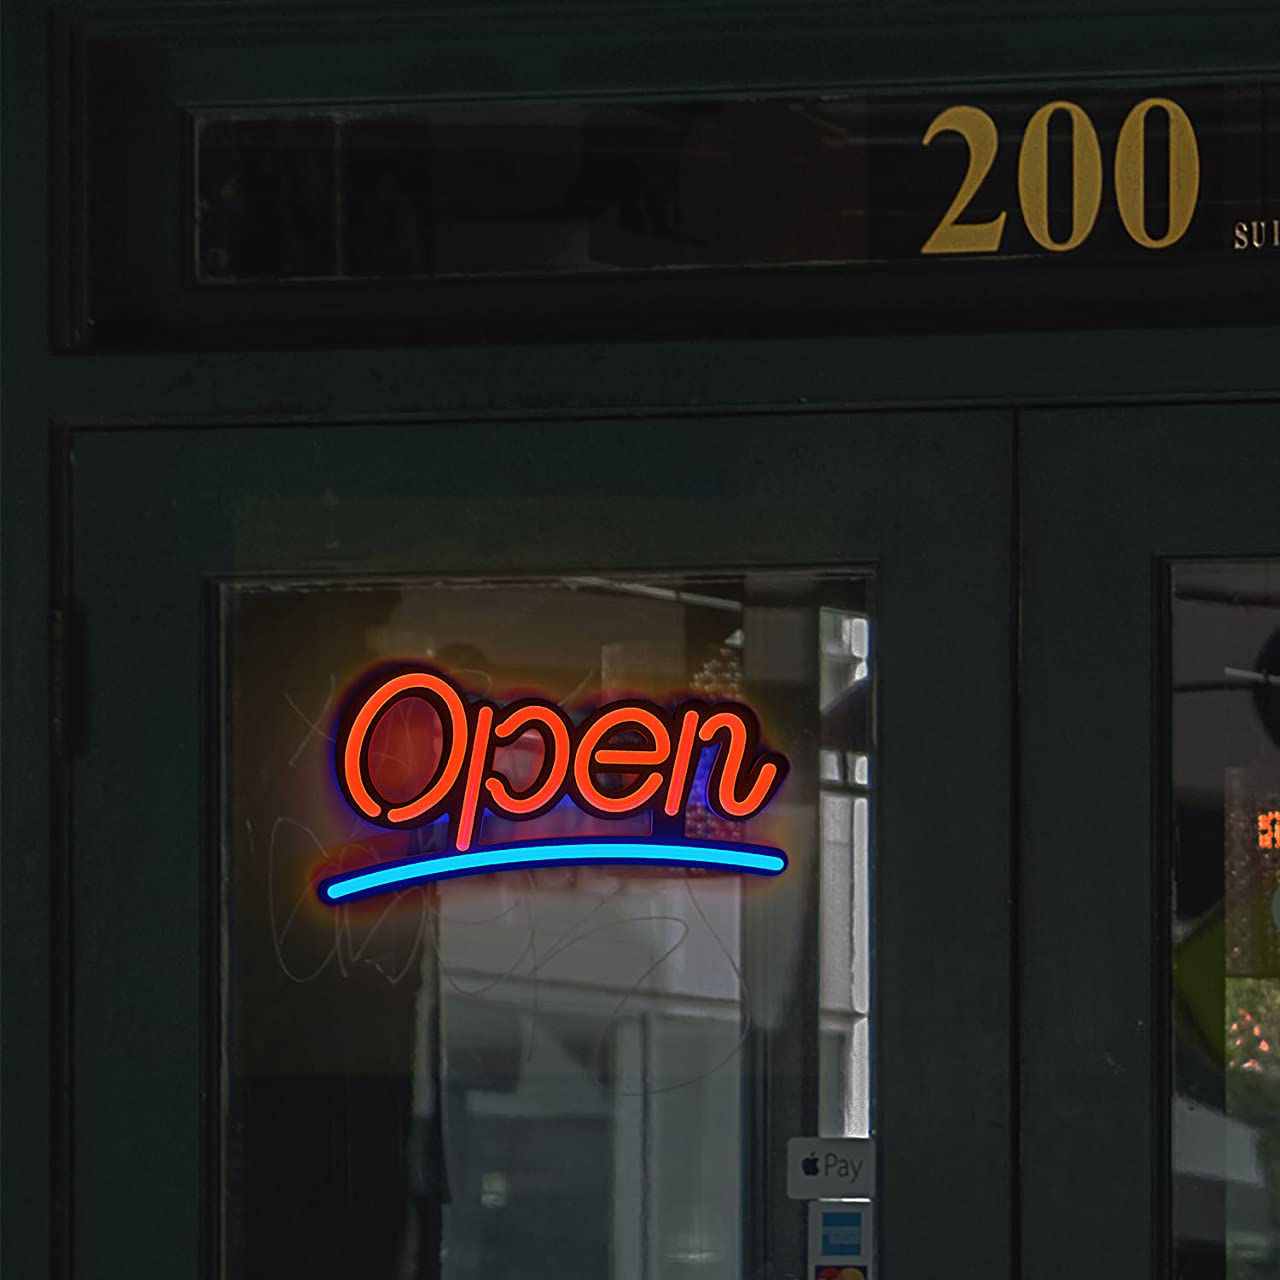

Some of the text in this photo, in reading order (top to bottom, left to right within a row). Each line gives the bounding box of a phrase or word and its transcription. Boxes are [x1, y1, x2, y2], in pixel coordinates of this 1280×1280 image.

[920, 97, 1200, 254] 200
[344, 672, 778, 851] Open
[824, 1152, 864, 1183] Pay
